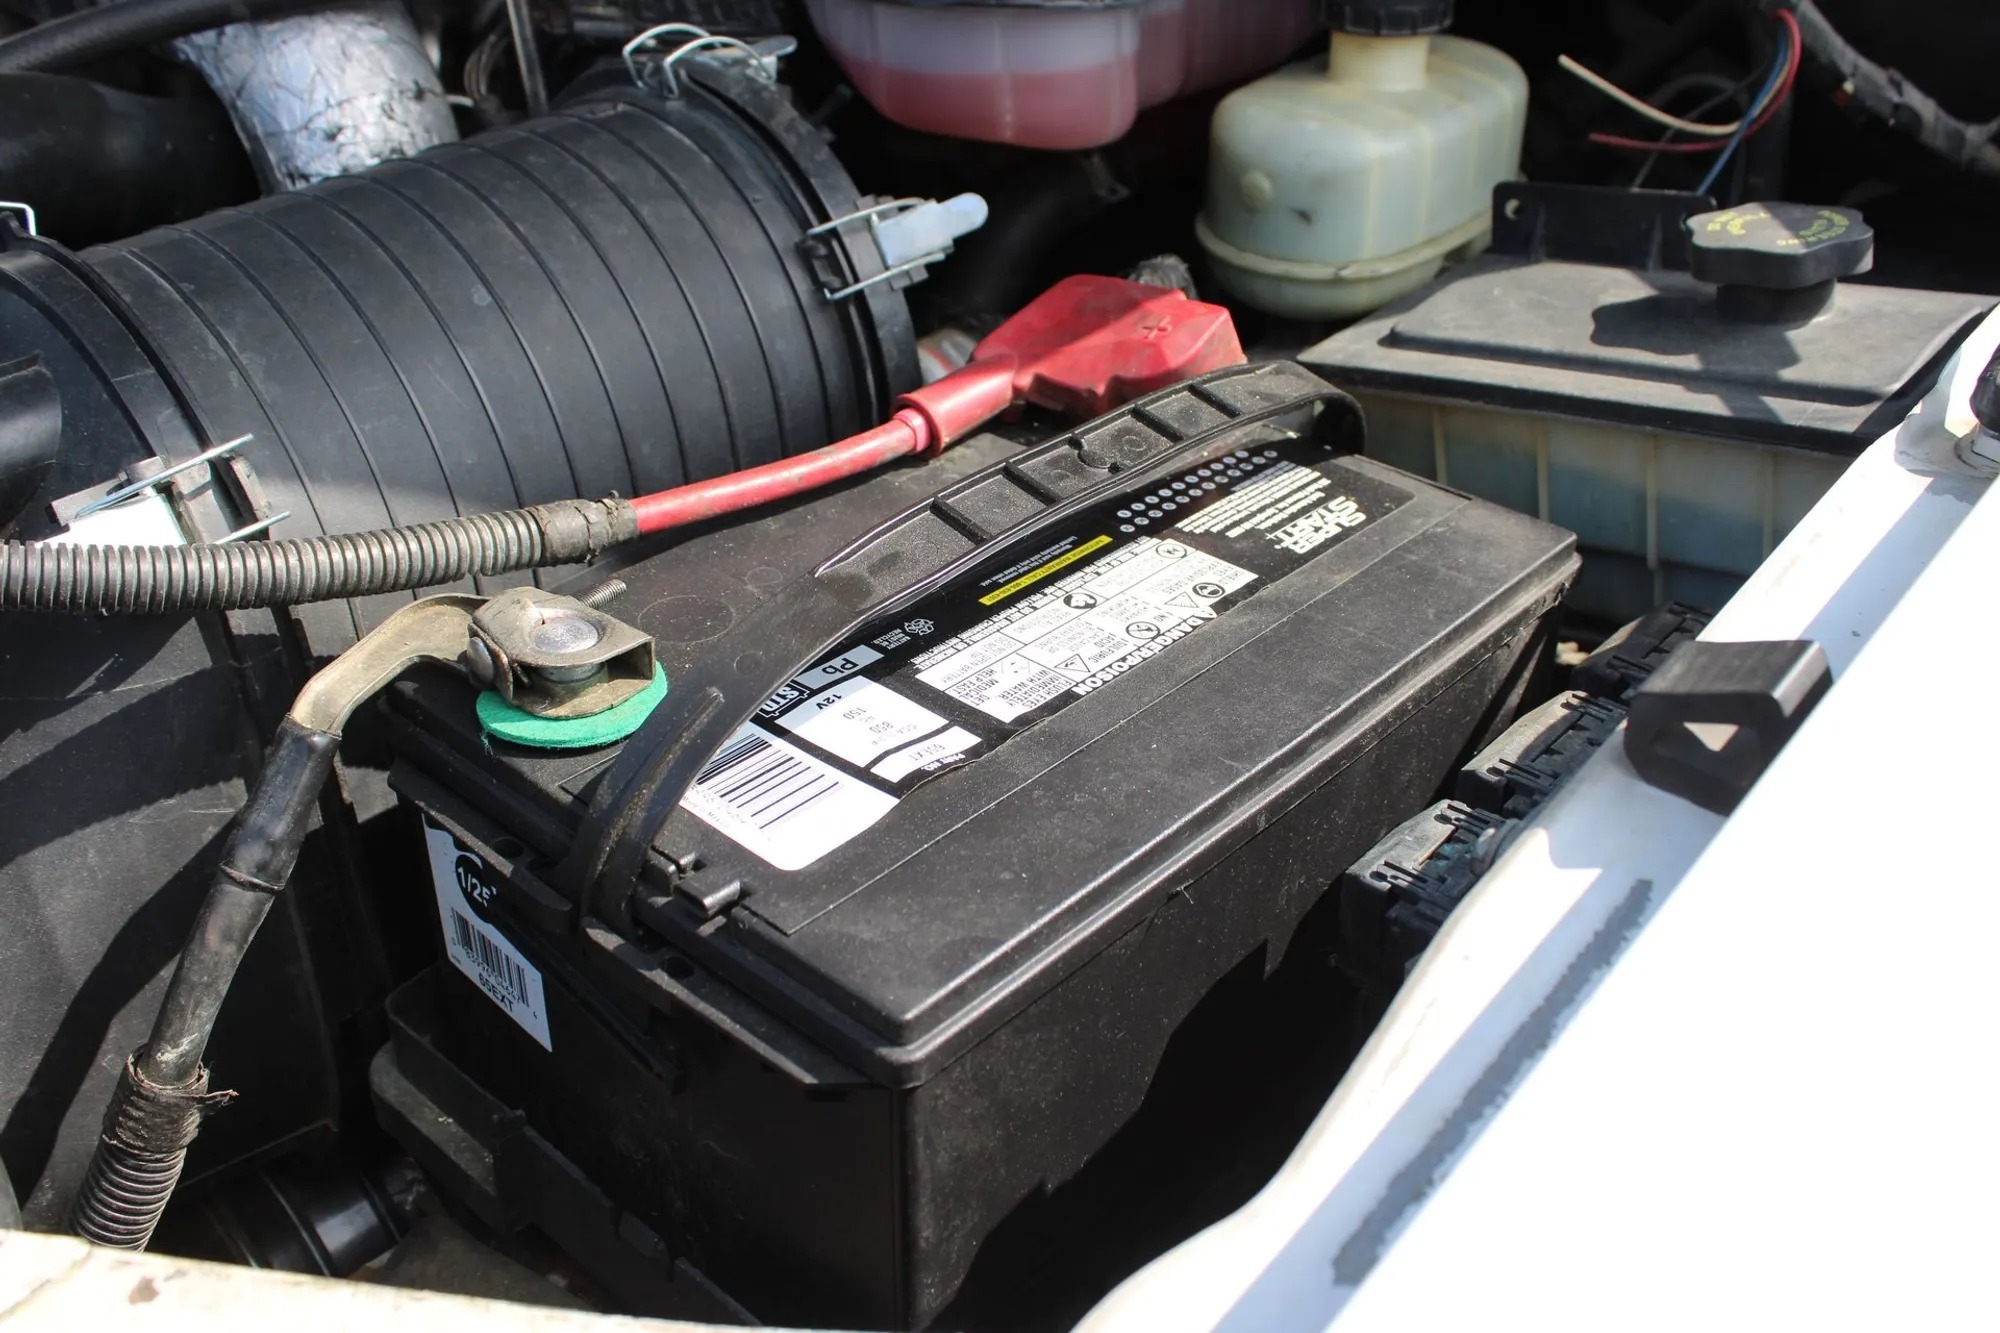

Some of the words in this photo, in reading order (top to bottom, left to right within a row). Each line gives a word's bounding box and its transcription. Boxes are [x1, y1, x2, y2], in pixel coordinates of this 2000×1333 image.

[1281, 496, 1360, 549] START
[1290, 511, 1367, 554] SUPER
[1151, 613, 1168, 622] NO
[1092, 635, 1115, 647] ACID
[1073, 617, 1204, 694] DANGER/POISON
[1086, 640, 1128, 663] SULFURIC
[822, 658, 859, 675] Pb
[971, 667, 998, 682] HELP
[1024, 669, 1051, 683] WITH
[958, 677, 999, 700] MEDICAL
[1004, 674, 1062, 706] IMMEDIATELY
[1042, 679, 1073, 696] FLUSH
[815, 693, 842, 710] 12V
[968, 693, 991, 706] GET
[1020, 693, 1048, 709] EYES
[842, 707, 866, 720] 150
[941, 751, 966, 765] PART
[479, 972, 514, 1013] 65EXT
